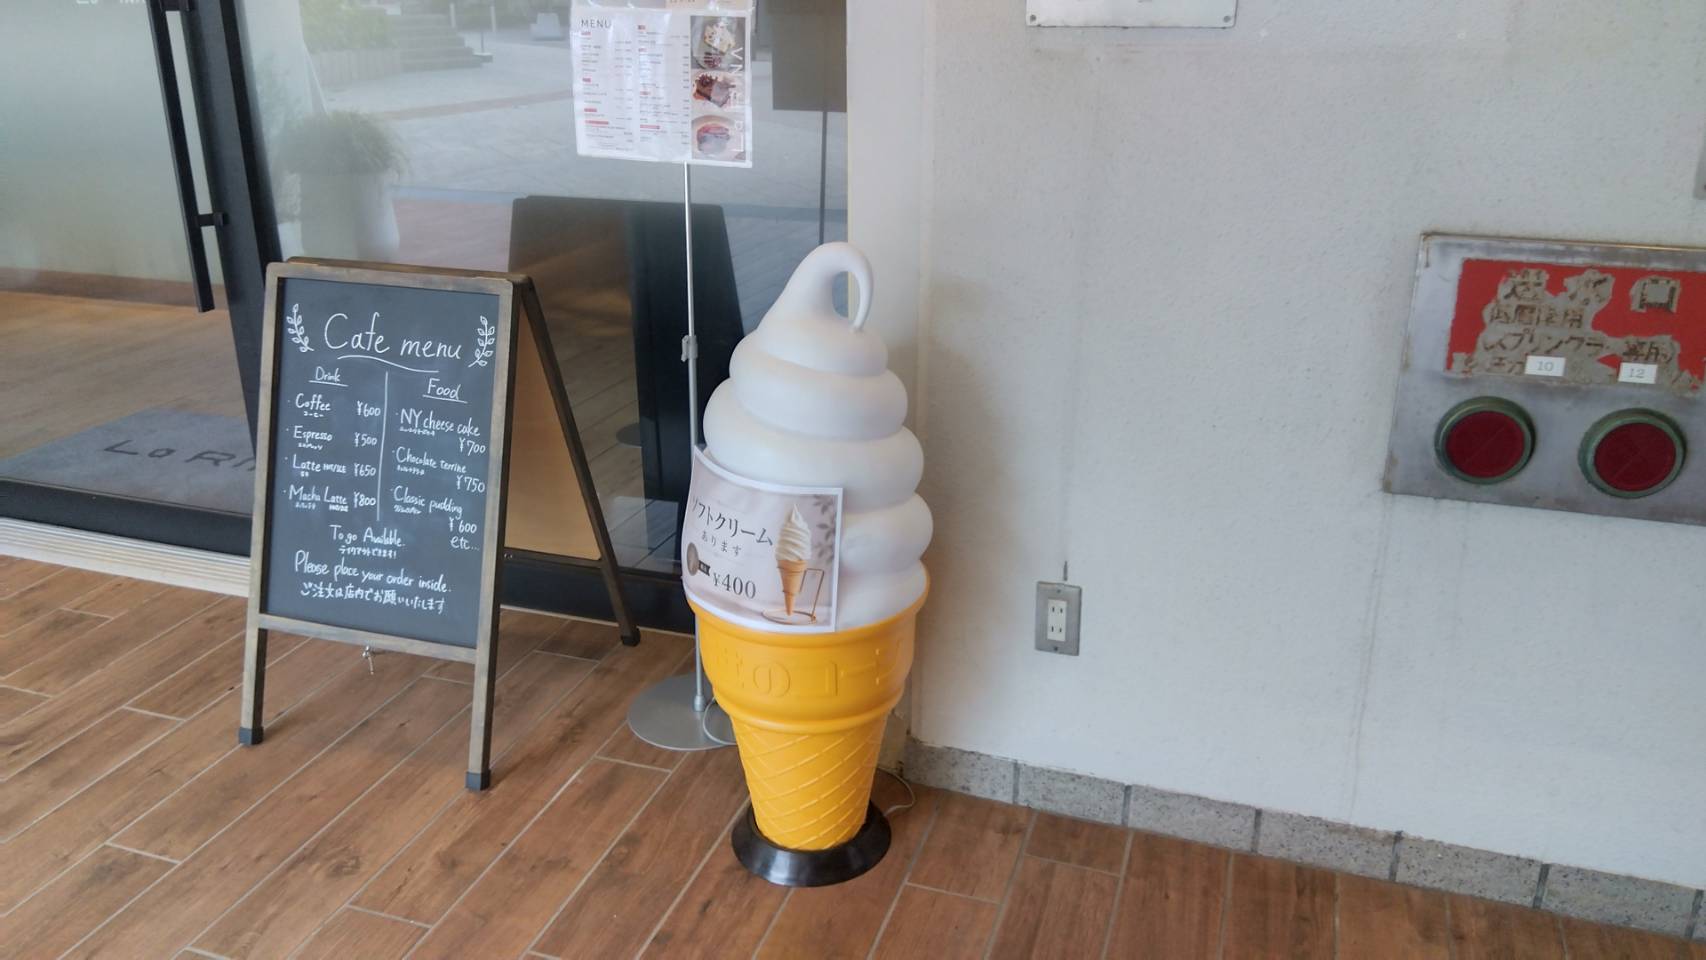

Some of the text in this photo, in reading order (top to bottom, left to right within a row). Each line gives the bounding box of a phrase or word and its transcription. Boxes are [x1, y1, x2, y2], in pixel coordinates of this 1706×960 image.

[581, 18, 612, 29] MENU
[324, 311, 461, 360] Cafe menu
[315, 366, 341, 382] Drink
[1536, 361, 1555, 372] 10
[1629, 367, 1646, 379] 12
[427, 378, 462, 400] Food
[295, 393, 381, 418] Coffee ¥600
[400, 408, 423, 428] NY
[423, 410, 454, 432] cheese
[457, 417, 480, 436] cake
[293, 425, 378, 447] Espresso ¥500
[459, 437, 486, 456] ¥700
[293, 453, 321, 472] Latte
[354, 462, 377, 477] ¥650
[396, 446, 437, 469] Chocolate
[457, 474, 486, 493] ¥750
[324, 486, 347, 504] Latte
[353, 491, 377, 508] ¥800
[394, 485, 425, 506] Classic
[429, 497, 463, 520] pudding
[449, 516, 478, 534] ¥600
[692, 496, 774, 546] ソフトクリーム
[701, 530, 742, 556] あります
[295, 550, 330, 575] Please
[334, 556, 359, 582] place
[361, 570, 383, 583] your
[386, 568, 414, 587] order
[713, 572, 757, 600] ¥400
